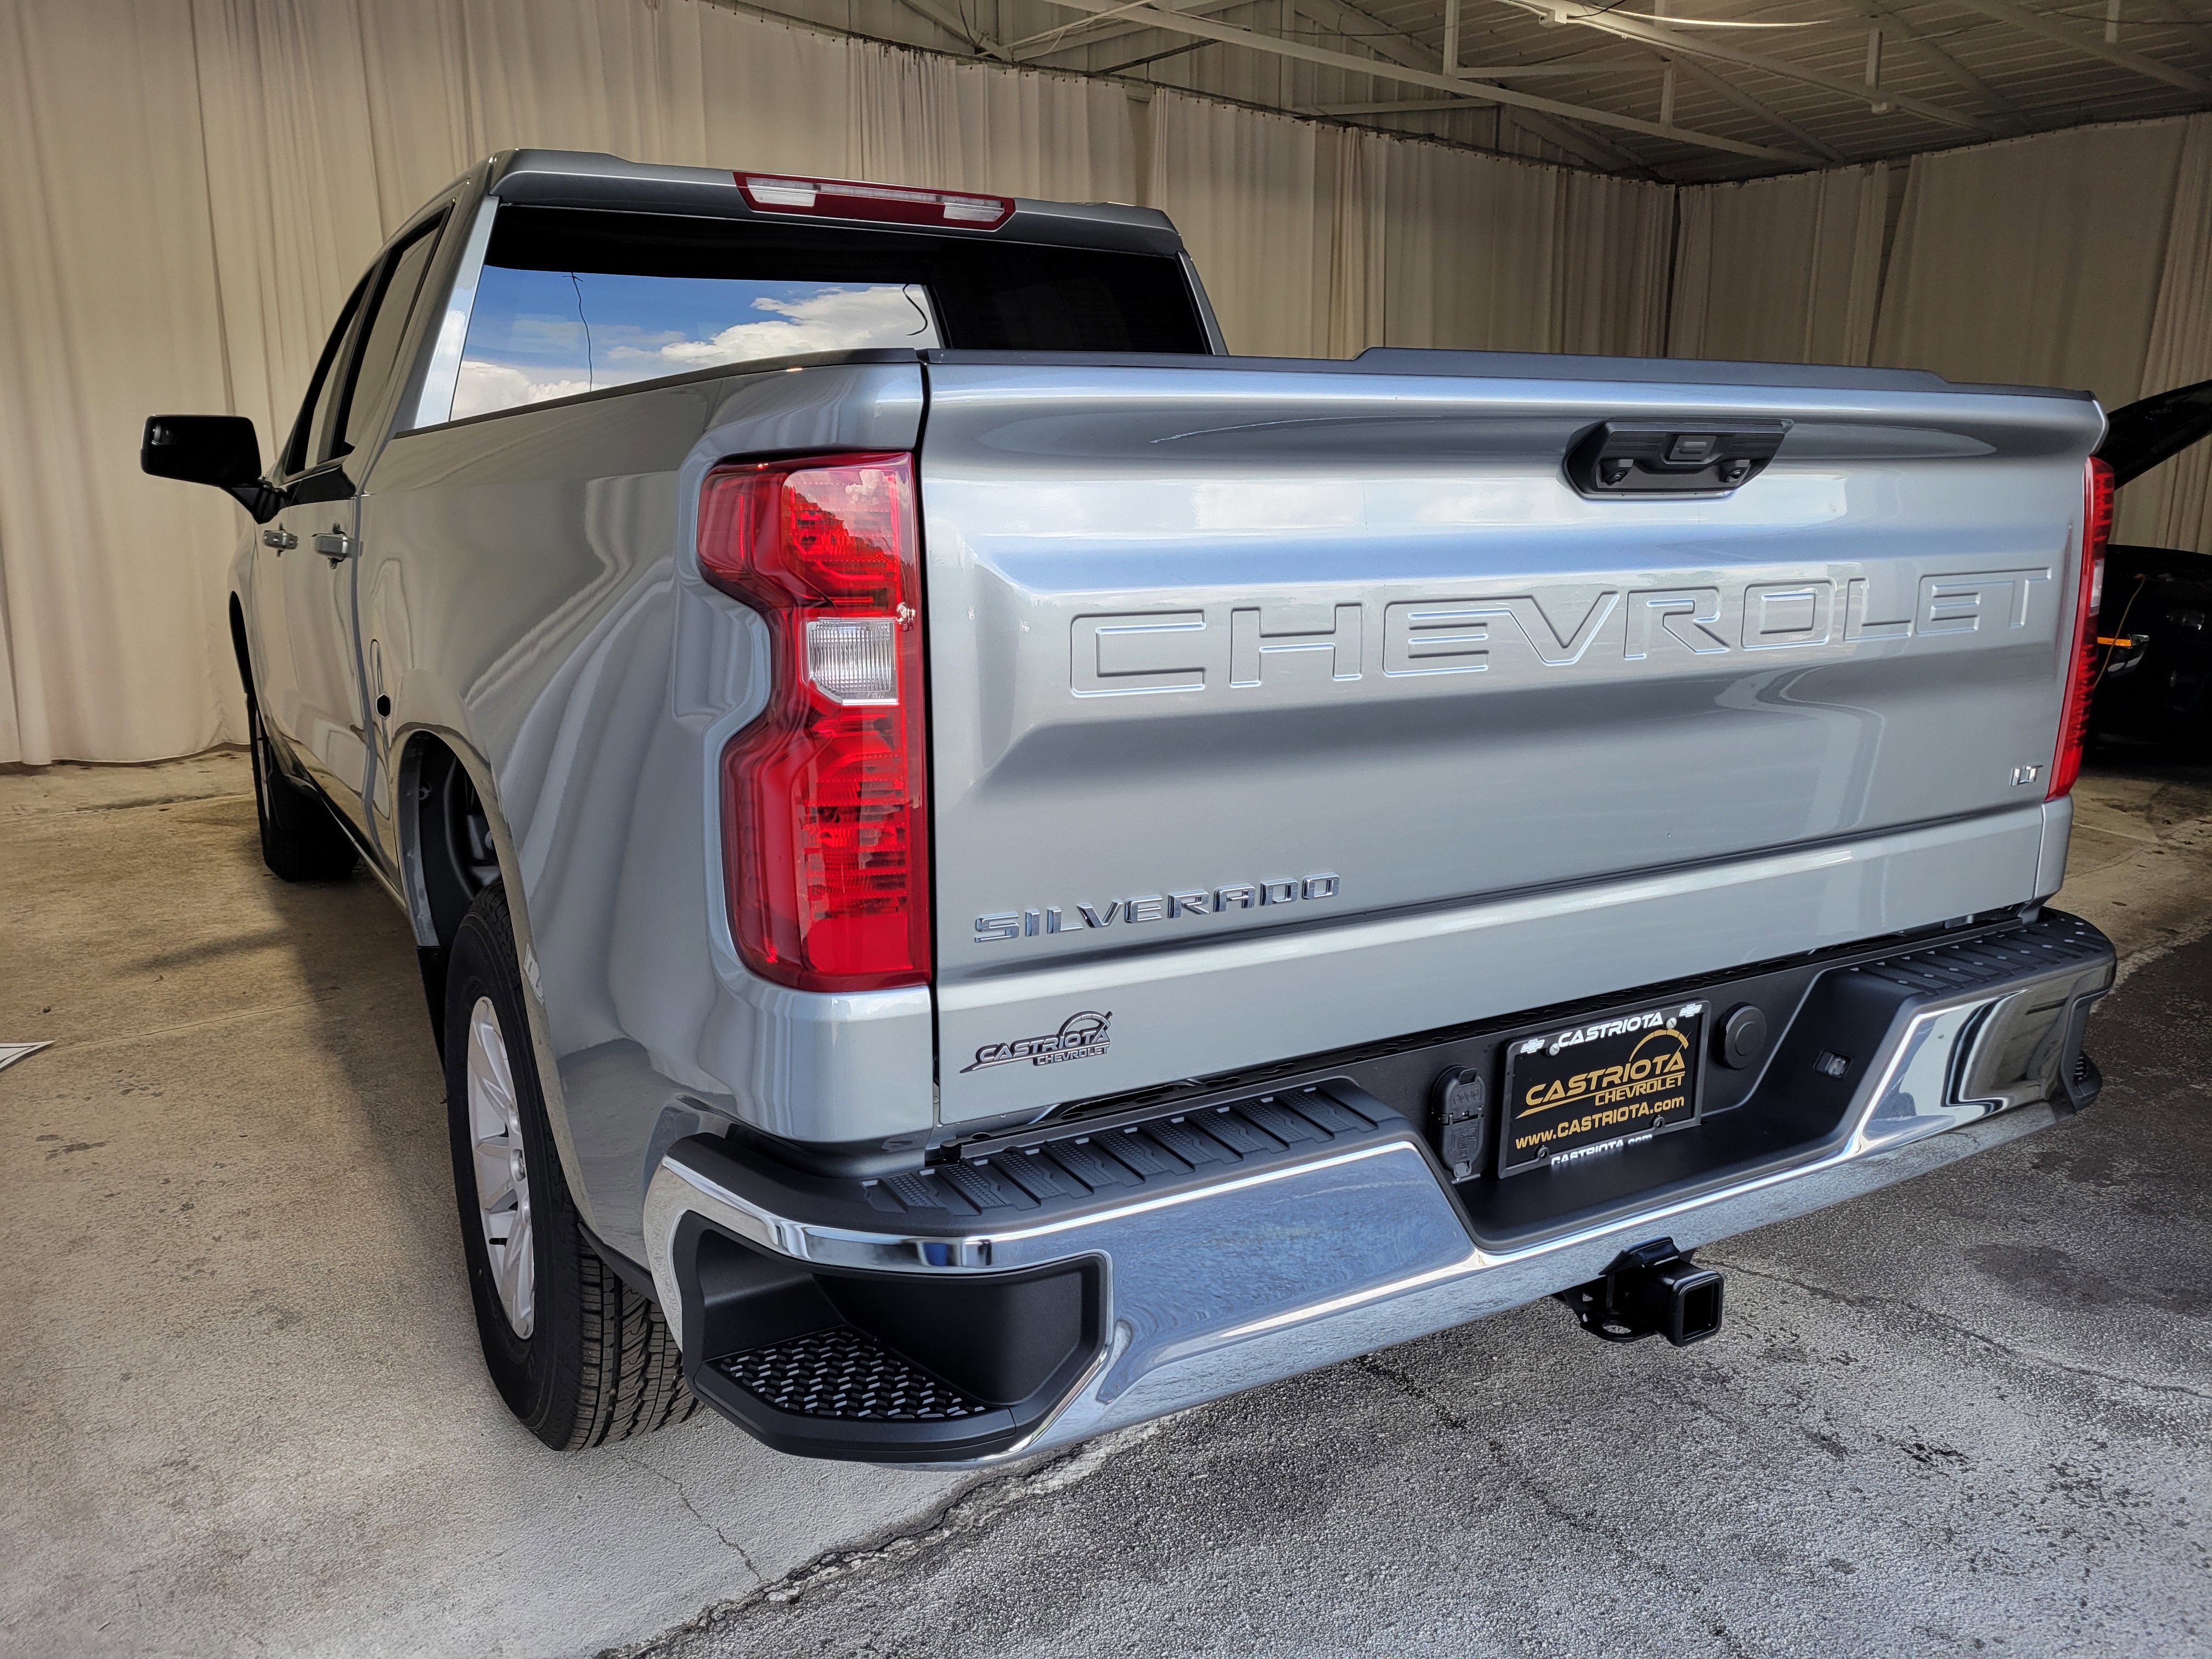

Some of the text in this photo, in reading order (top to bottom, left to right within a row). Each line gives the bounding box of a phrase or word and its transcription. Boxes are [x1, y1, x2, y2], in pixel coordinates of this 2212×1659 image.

[1070, 566, 2052, 697] CHEVROLET
[2009, 764, 2043, 786] LT
[974, 872, 1340, 943] SILVERADO
[978, 1028, 1110, 1062] CASTRIOTA
[1558, 1012, 1664, 1047] CASTRIOTA
[1036, 1045, 1110, 1065] CHEVROLET
[1525, 1051, 1685, 1106] CASTRIOTA
[1595, 1073, 1685, 1107] CHEVROLET
[1515, 1096, 1685, 1149] www.CASTRIOTA.com
